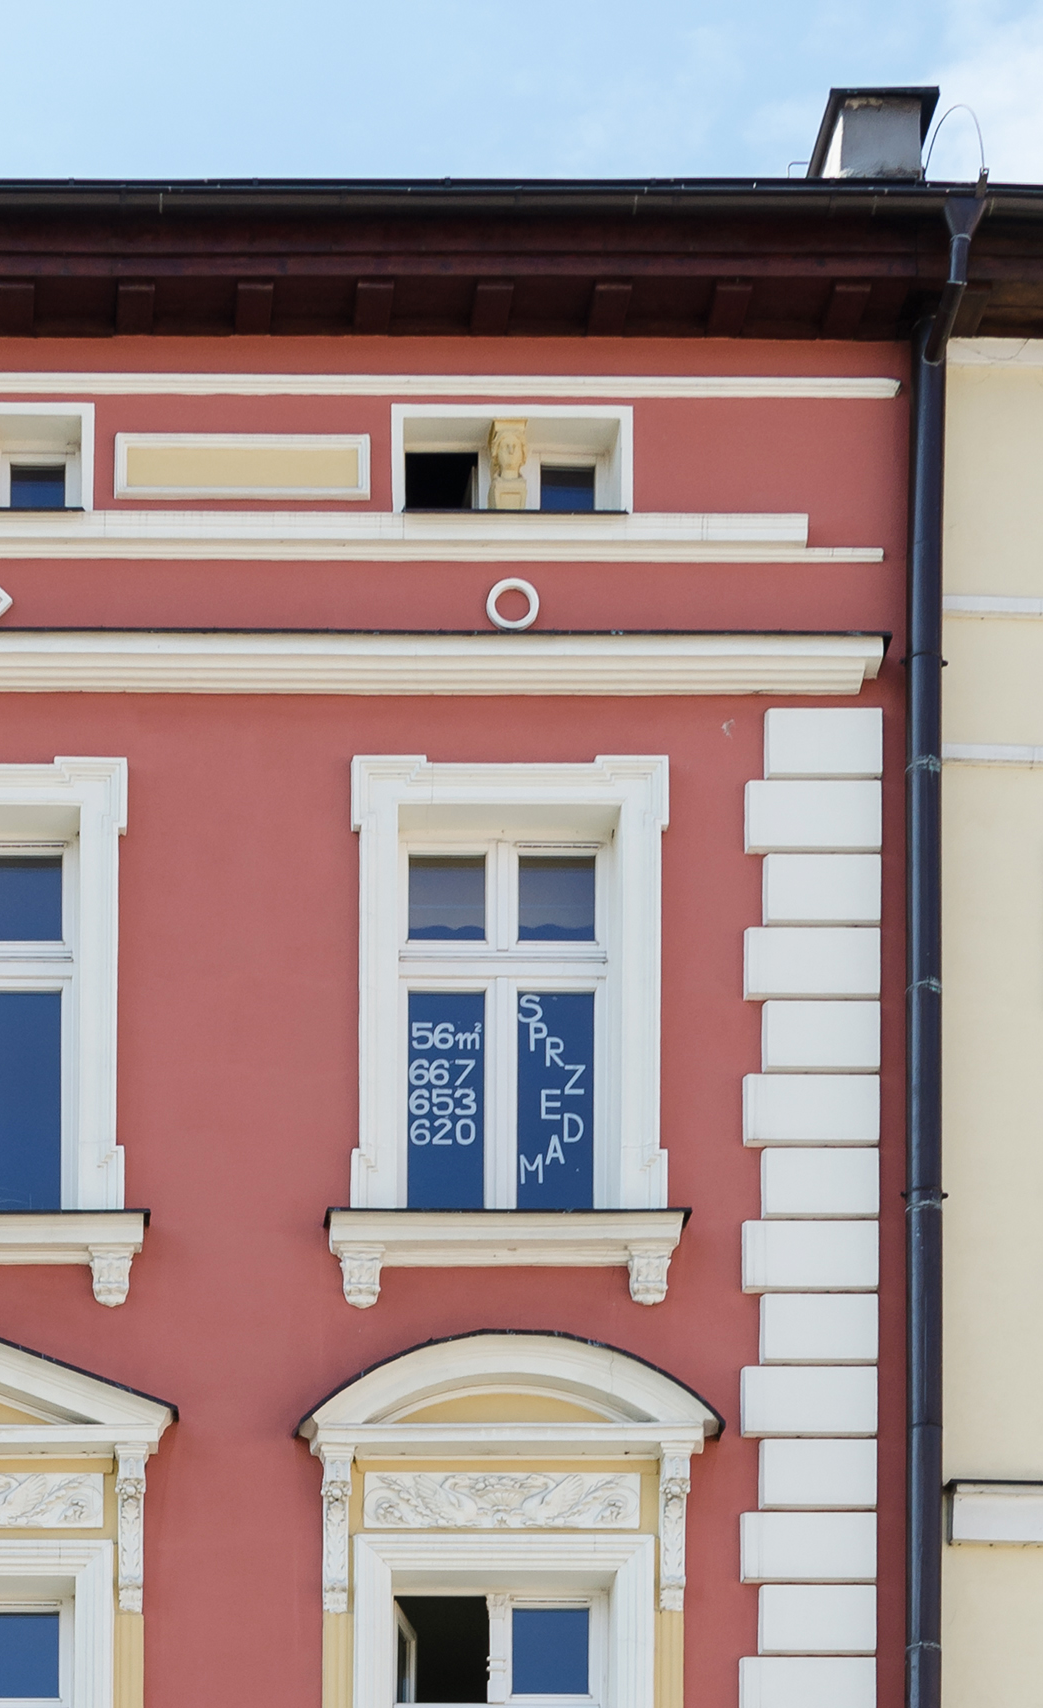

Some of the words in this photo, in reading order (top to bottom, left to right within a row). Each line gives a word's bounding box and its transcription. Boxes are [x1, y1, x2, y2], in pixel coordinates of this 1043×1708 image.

[409, 1059, 476, 1086] 667
[409, 1088, 477, 1116] 653
[410, 1118, 476, 1146] 620
